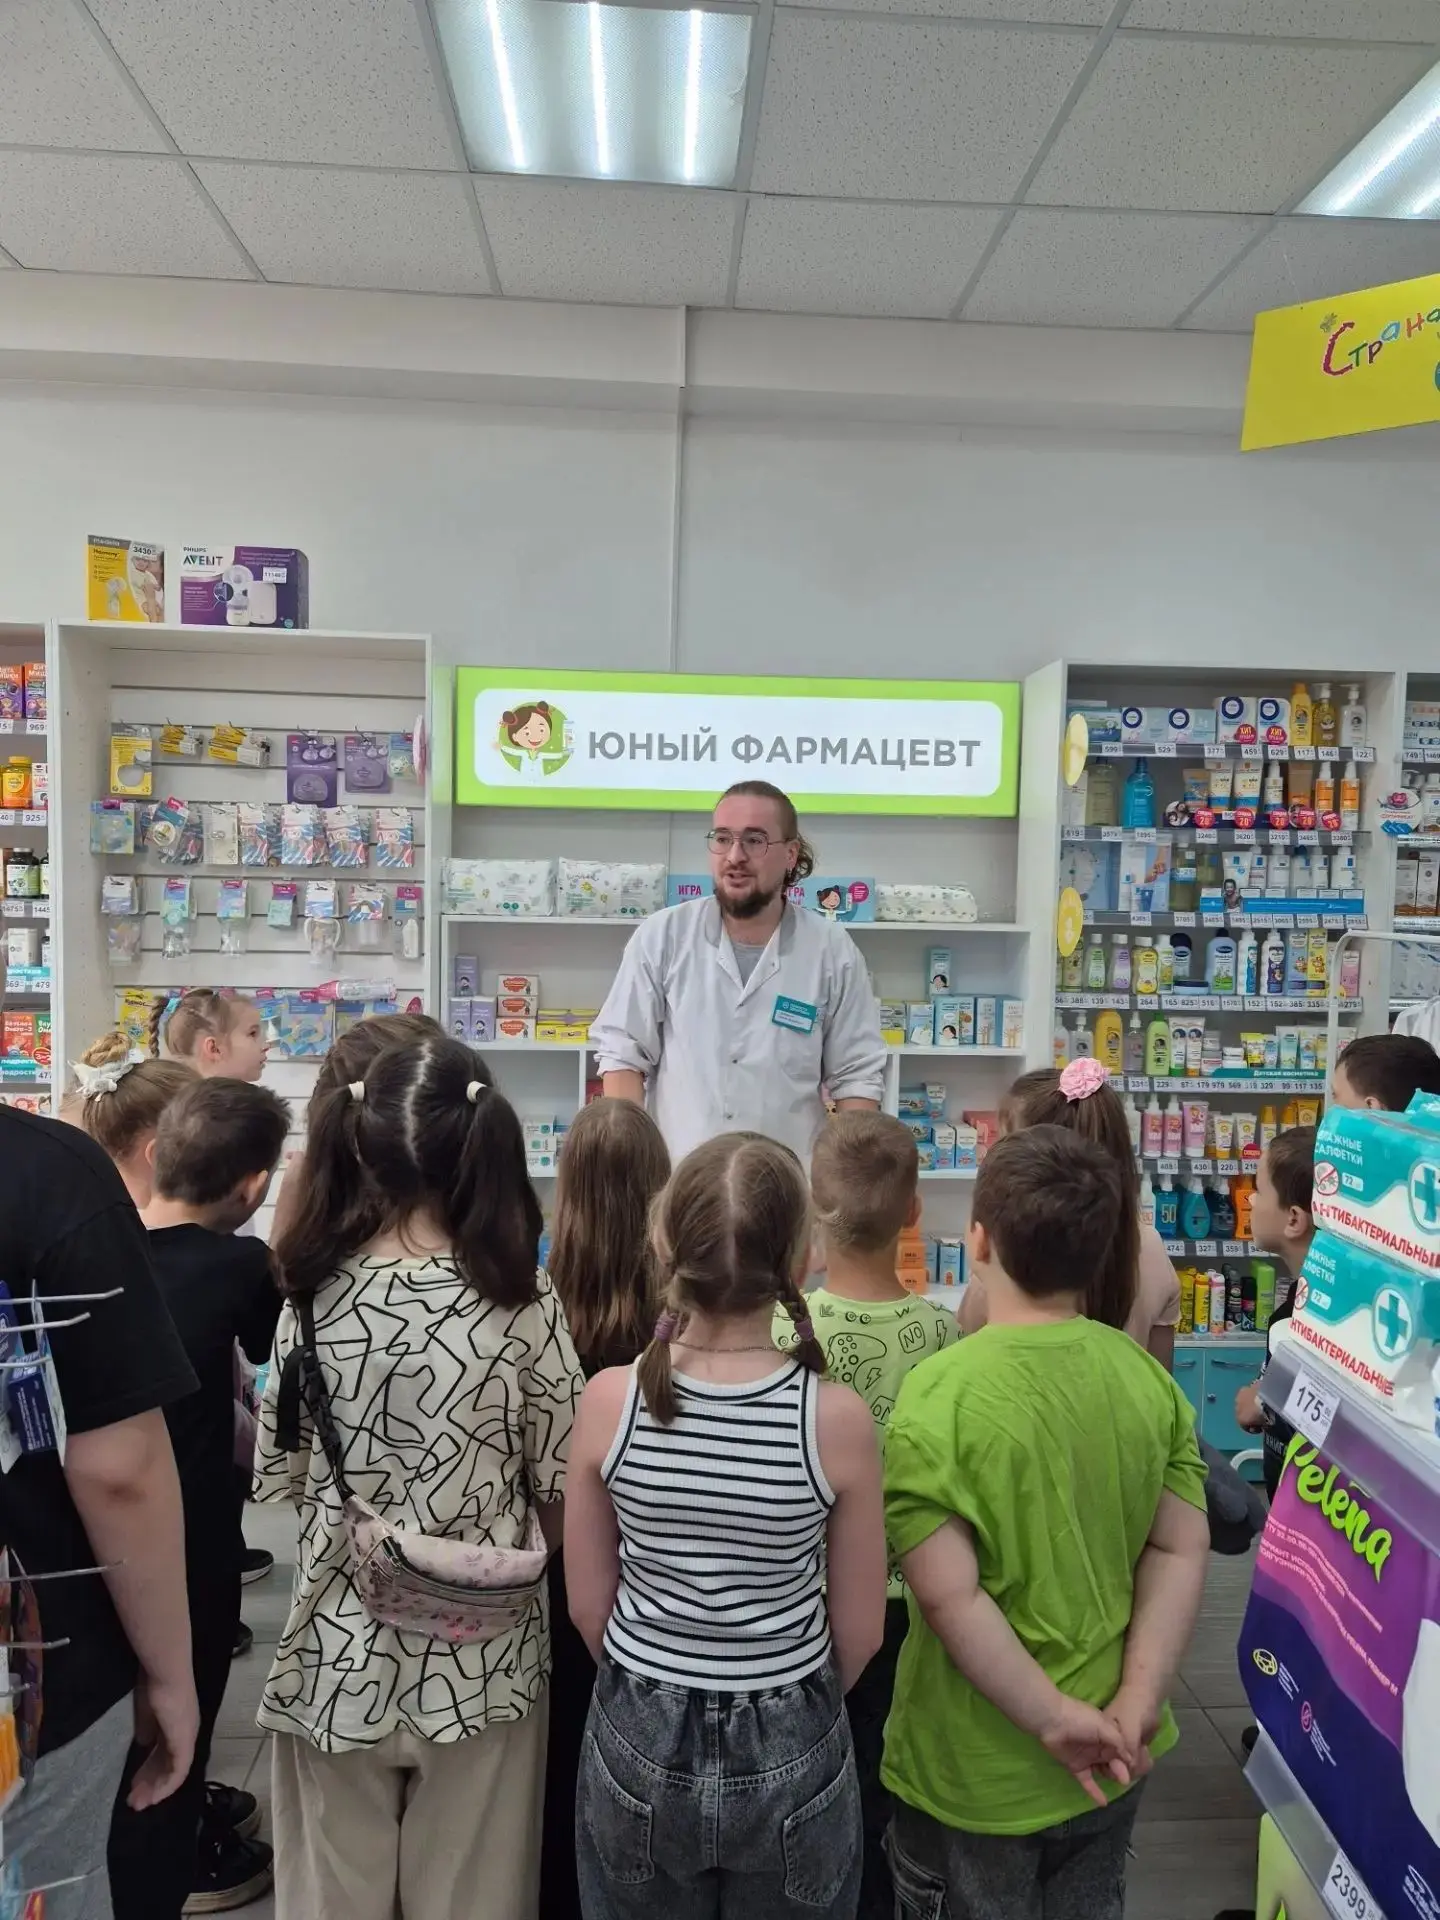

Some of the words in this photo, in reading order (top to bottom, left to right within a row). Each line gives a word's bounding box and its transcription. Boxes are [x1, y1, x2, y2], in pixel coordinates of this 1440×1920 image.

[133, 546, 152, 555] 3430
[183, 555, 223, 566] AVENT
[587, 725, 718, 763] ЮНЫЙ
[731, 734, 981, 771] ФАРМАЦЕВТ
[25, 814, 41, 822] 925
[678, 884, 702, 896] ИГРА
[1289, 1317, 1395, 1397] НТИБАКТЕРИАЛЬНЫЕ
[1296, 1386, 1325, 1422] 175
[1330, 1863, 1366, 1920] 2399
